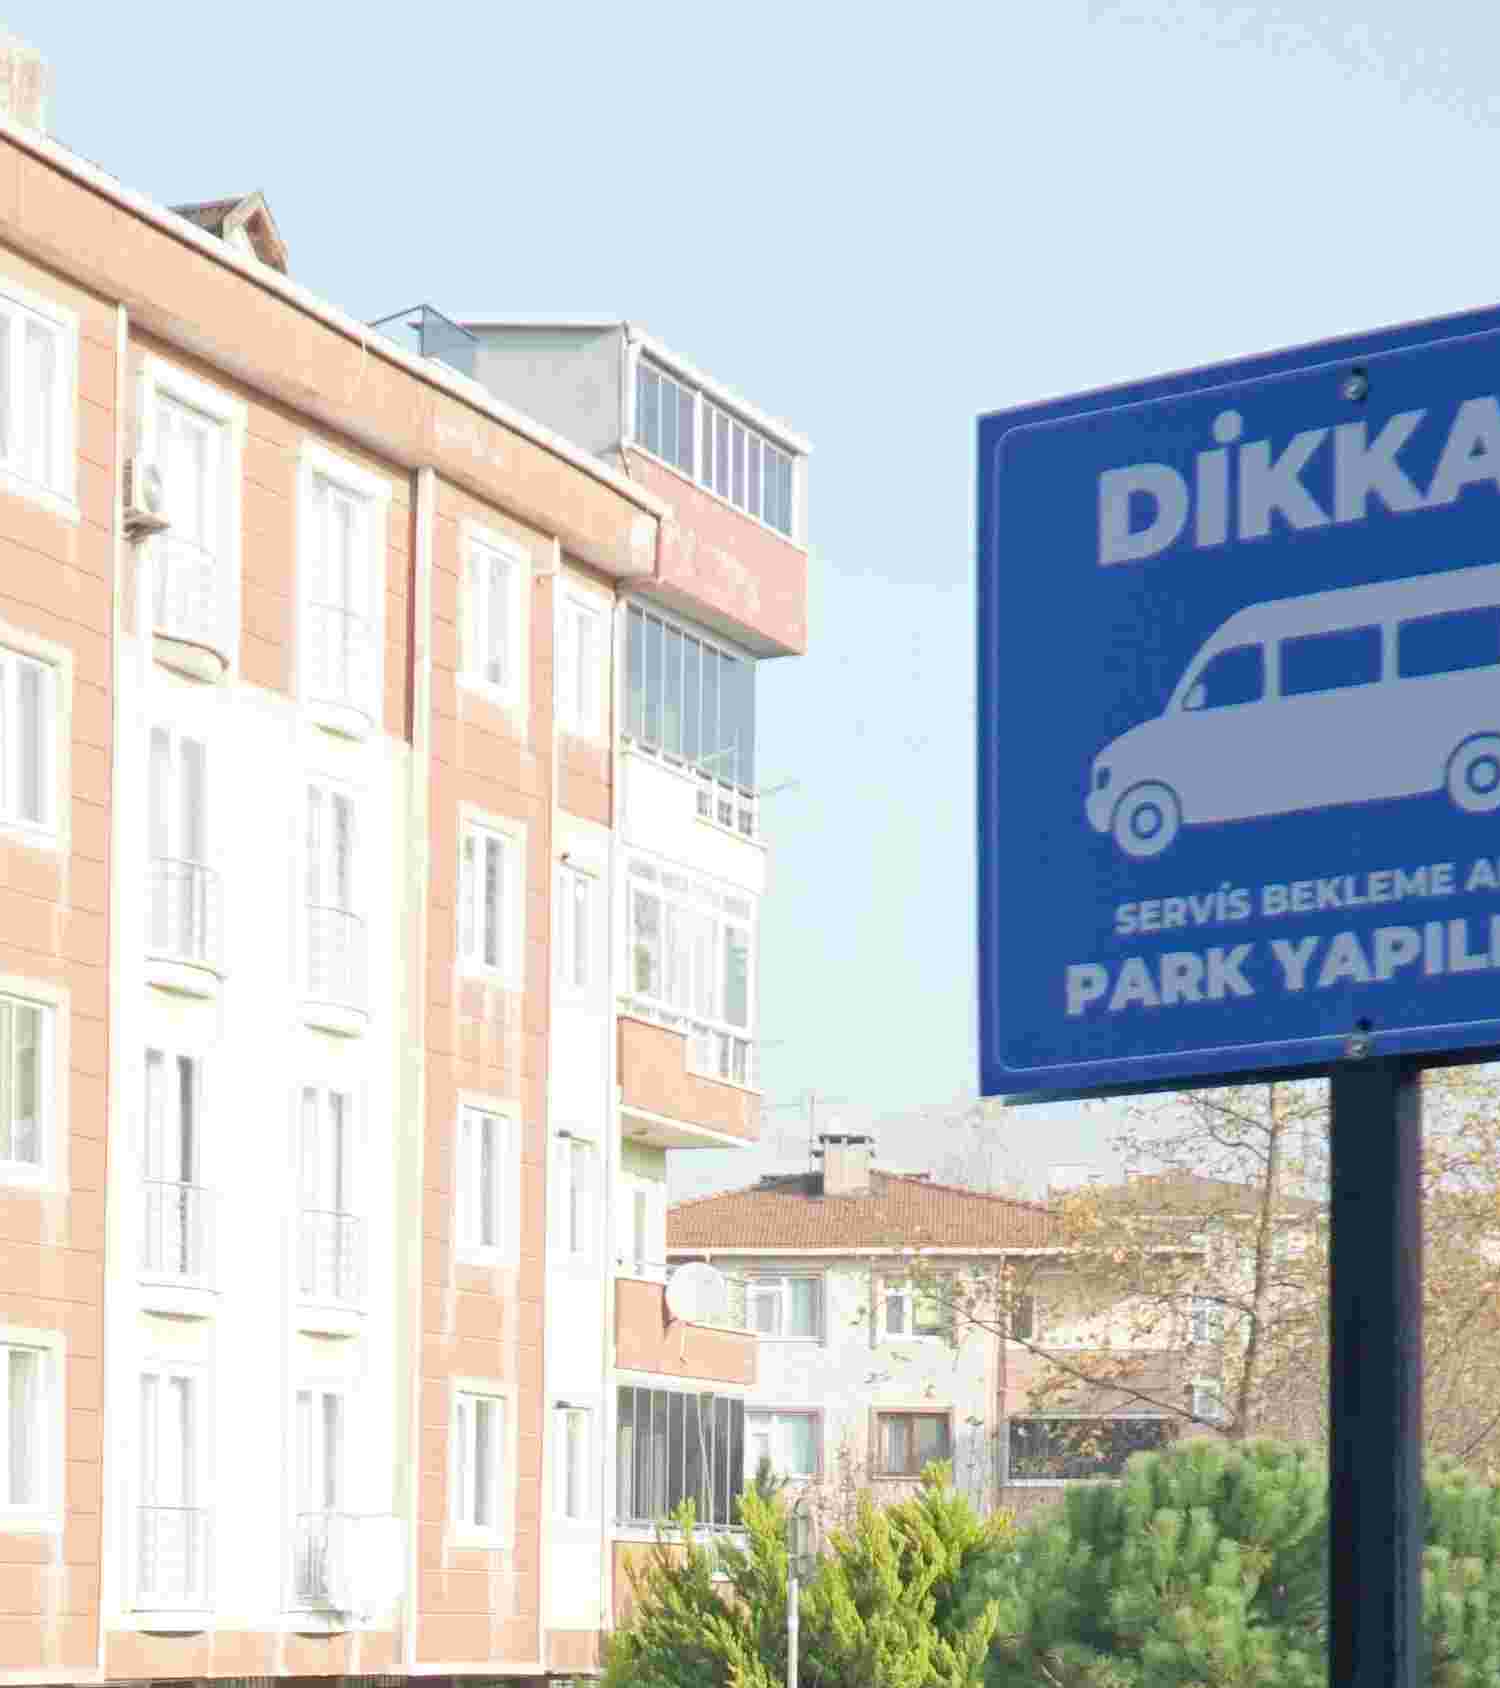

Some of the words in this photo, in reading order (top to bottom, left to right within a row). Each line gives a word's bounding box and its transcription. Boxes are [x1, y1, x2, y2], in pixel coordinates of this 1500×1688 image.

[1114, 885, 1251, 935] SERVİS
[1262, 864, 1454, 917] BEKLEME
[1065, 942, 1254, 1016] PARK
